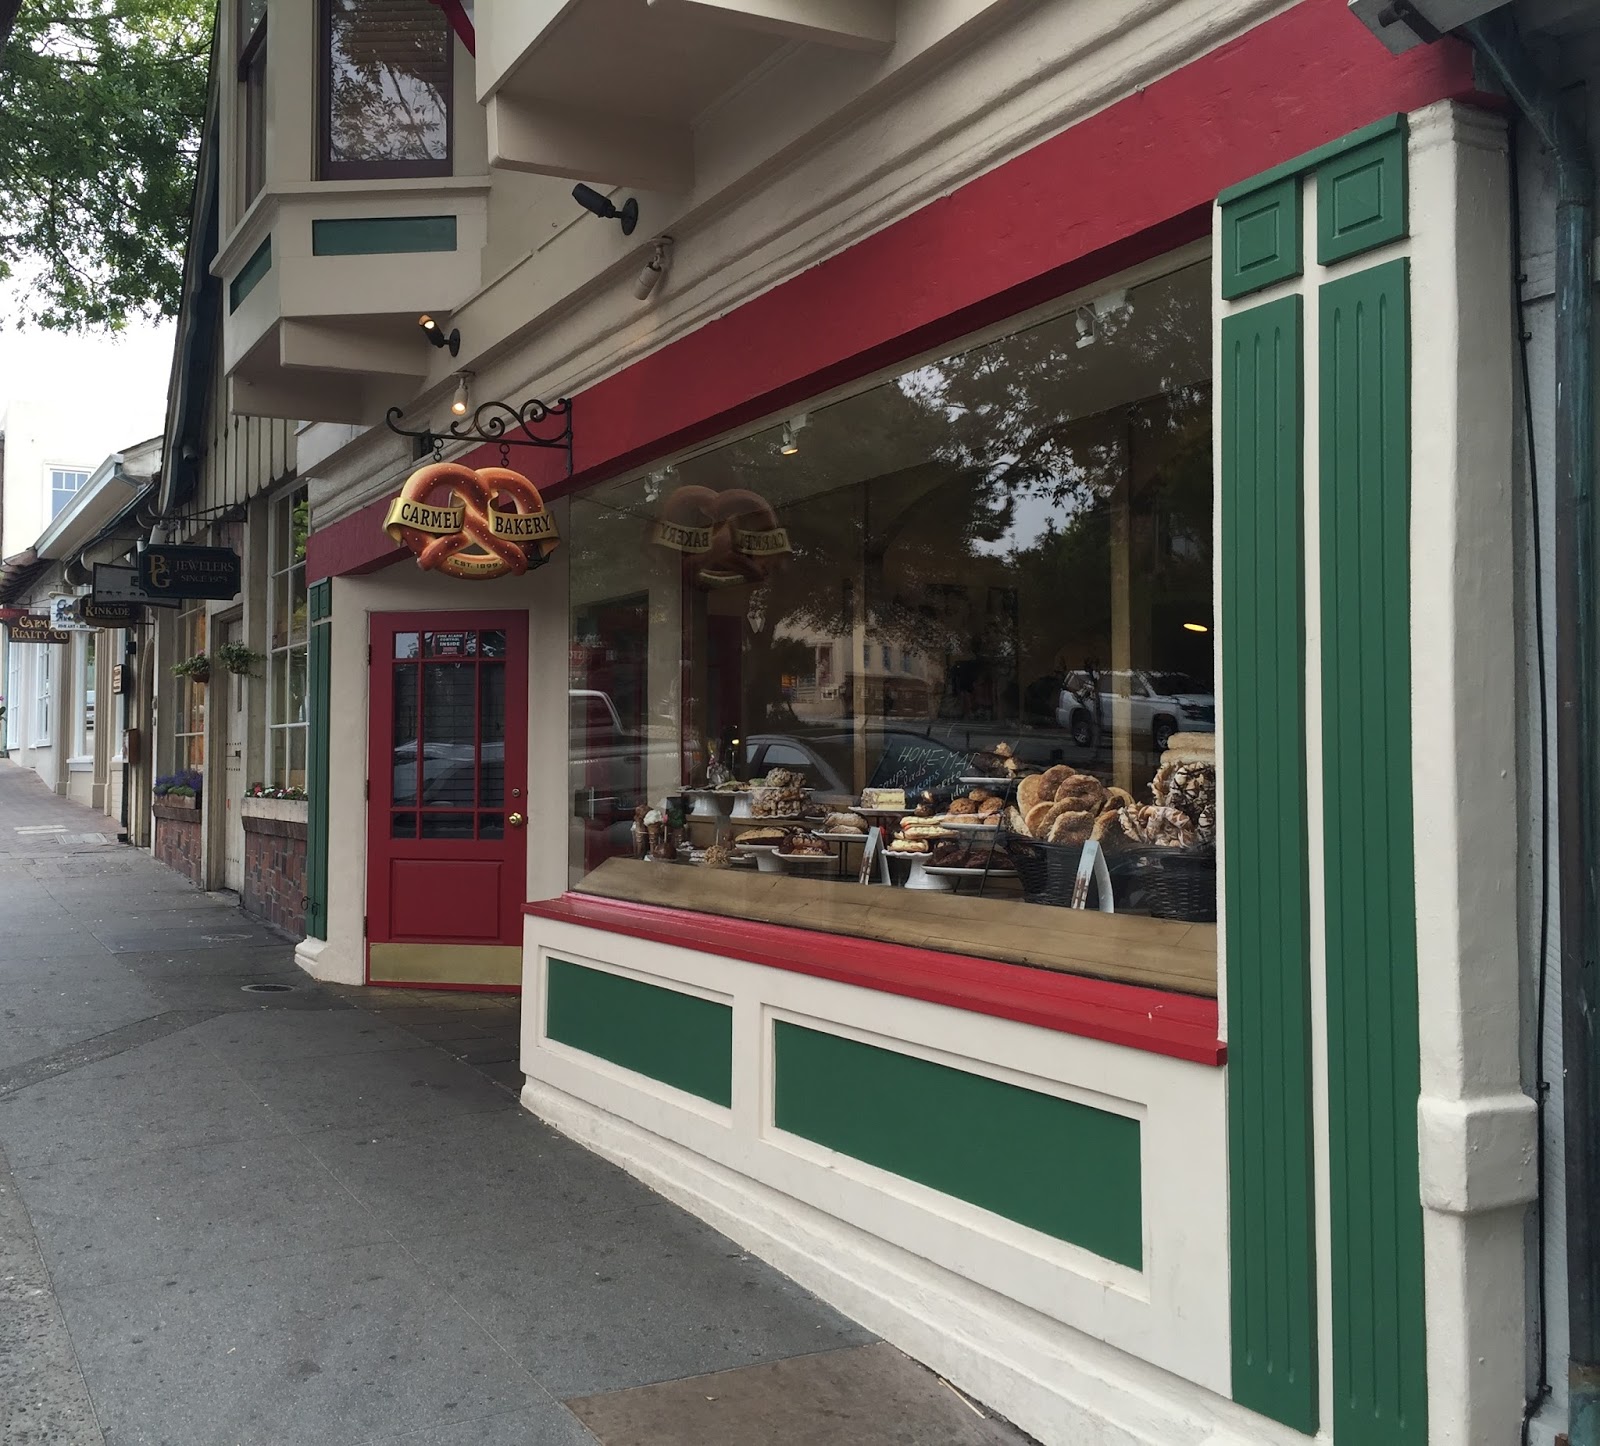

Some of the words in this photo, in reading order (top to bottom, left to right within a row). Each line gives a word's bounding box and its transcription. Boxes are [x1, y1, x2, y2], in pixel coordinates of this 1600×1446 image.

[401, 503, 462, 529] CARMEL
[495, 514, 552, 535] BAKERY
[174, 559, 234, 573] JEWELERS
[181, 574, 207, 583] SINCE
[85, 606, 130, 617] KINKADE
[19, 615, 50, 628] CARM
[11, 626, 49, 639] REALTY
